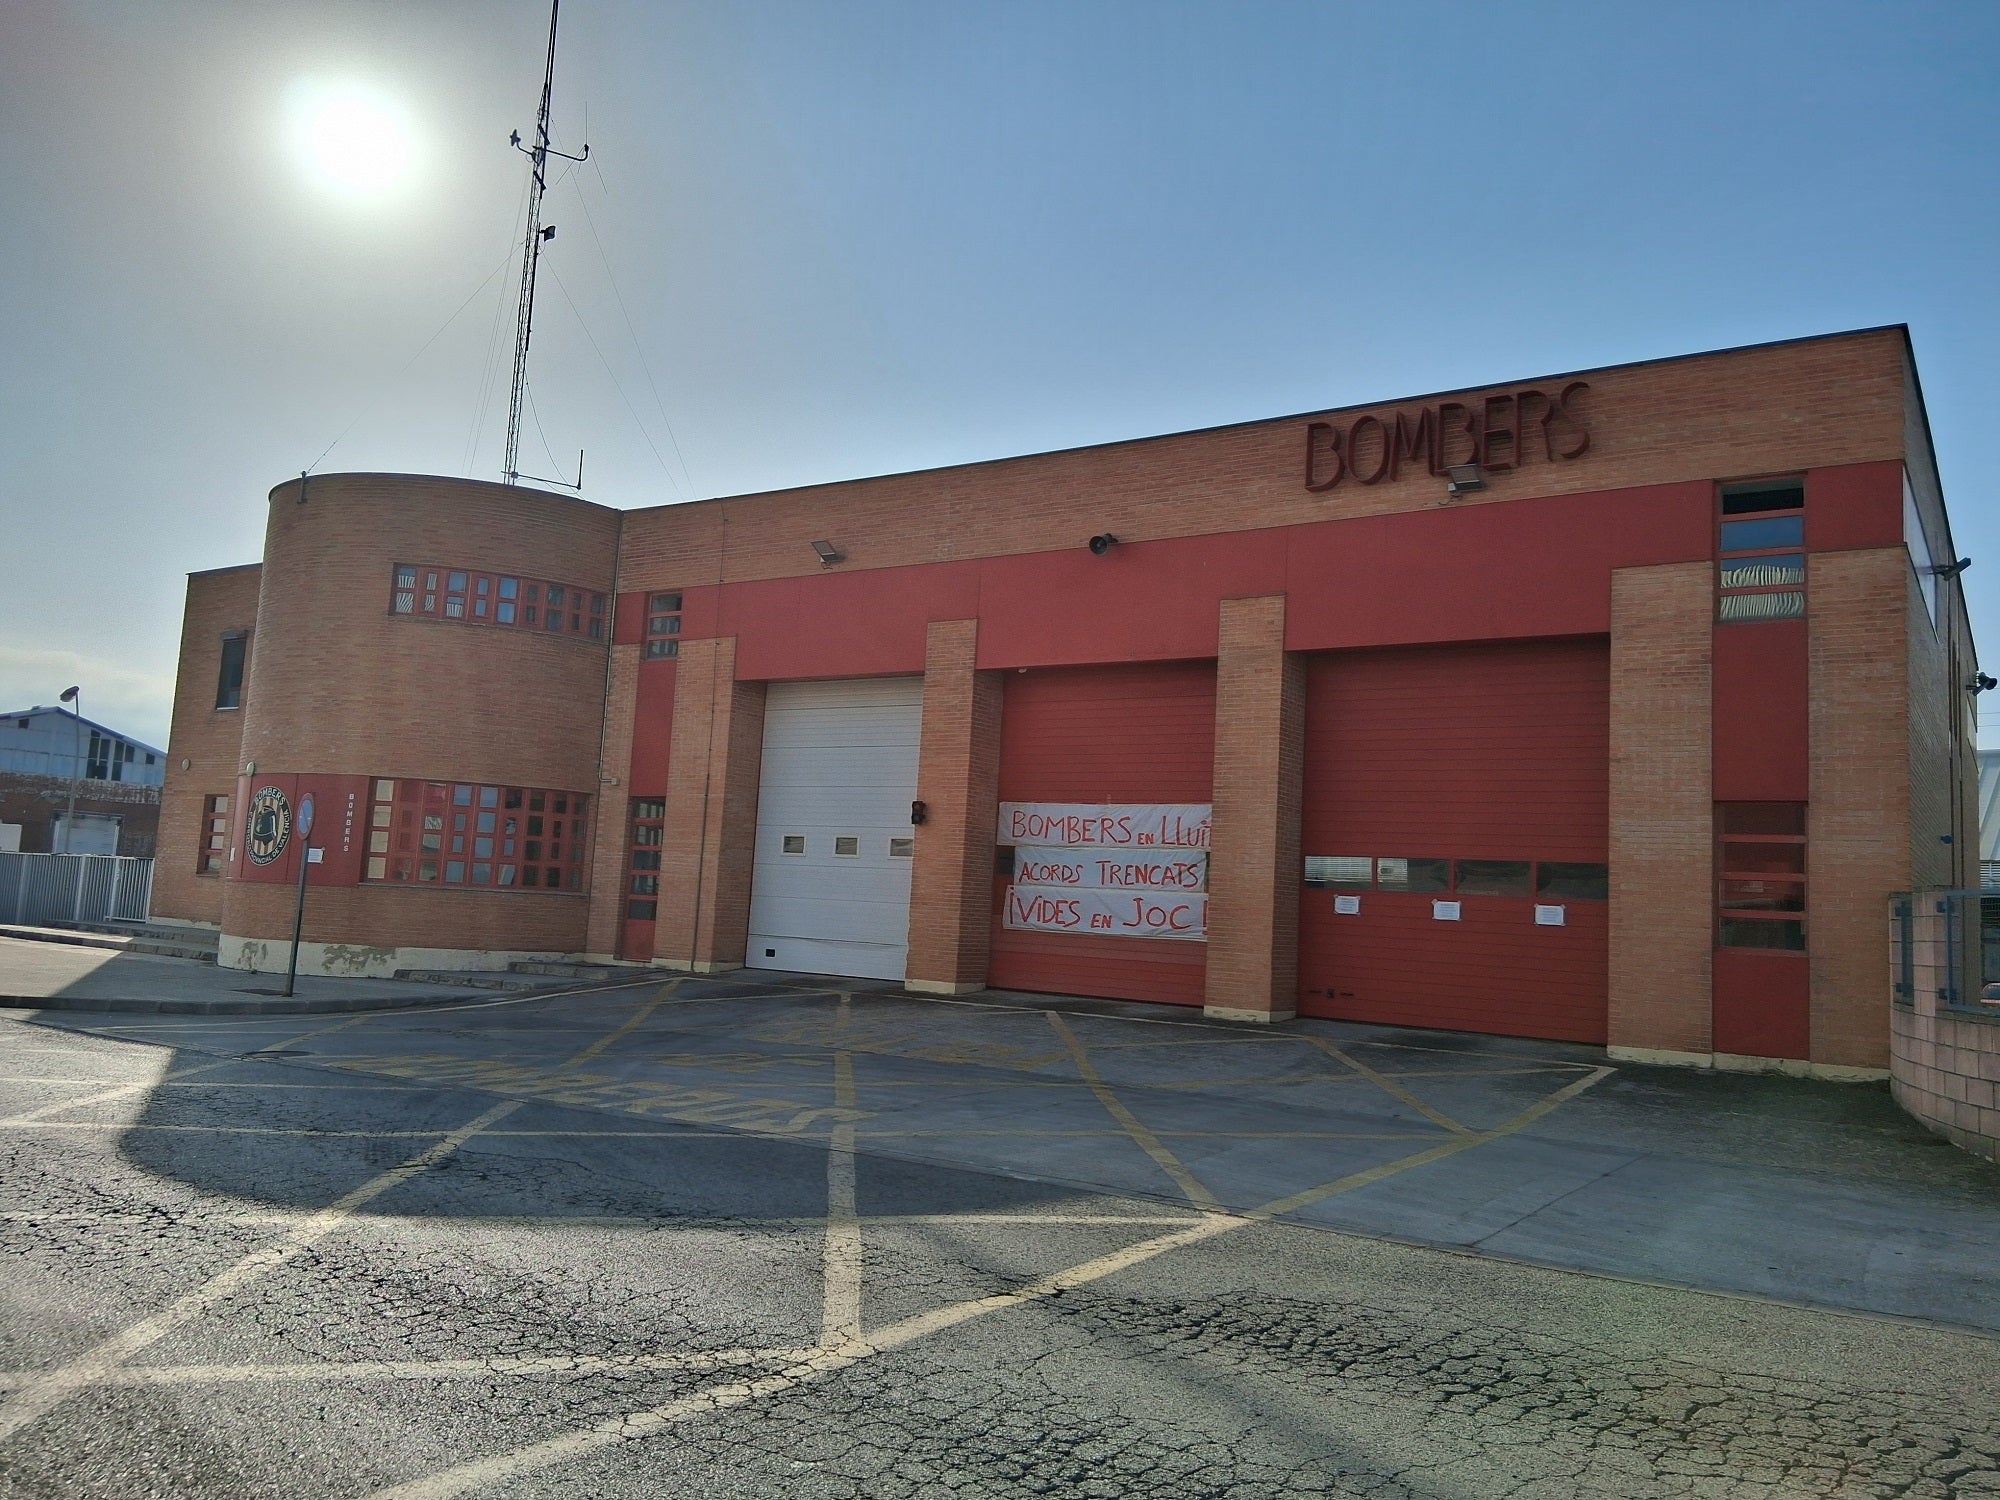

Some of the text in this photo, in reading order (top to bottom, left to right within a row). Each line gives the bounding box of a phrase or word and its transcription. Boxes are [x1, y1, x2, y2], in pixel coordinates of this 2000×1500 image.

[1305, 381, 1590, 492] BOMBERS
[343, 793, 354, 851] BOMBERS
[1011, 810, 1132, 844] BOMBERS
[1137, 832, 1154, 845] EN
[1019, 860, 1198, 888] ACORDS TRENCATS
[1090, 914, 1112, 929] EN
[322, 1053, 876, 1133] BOMBEROS
